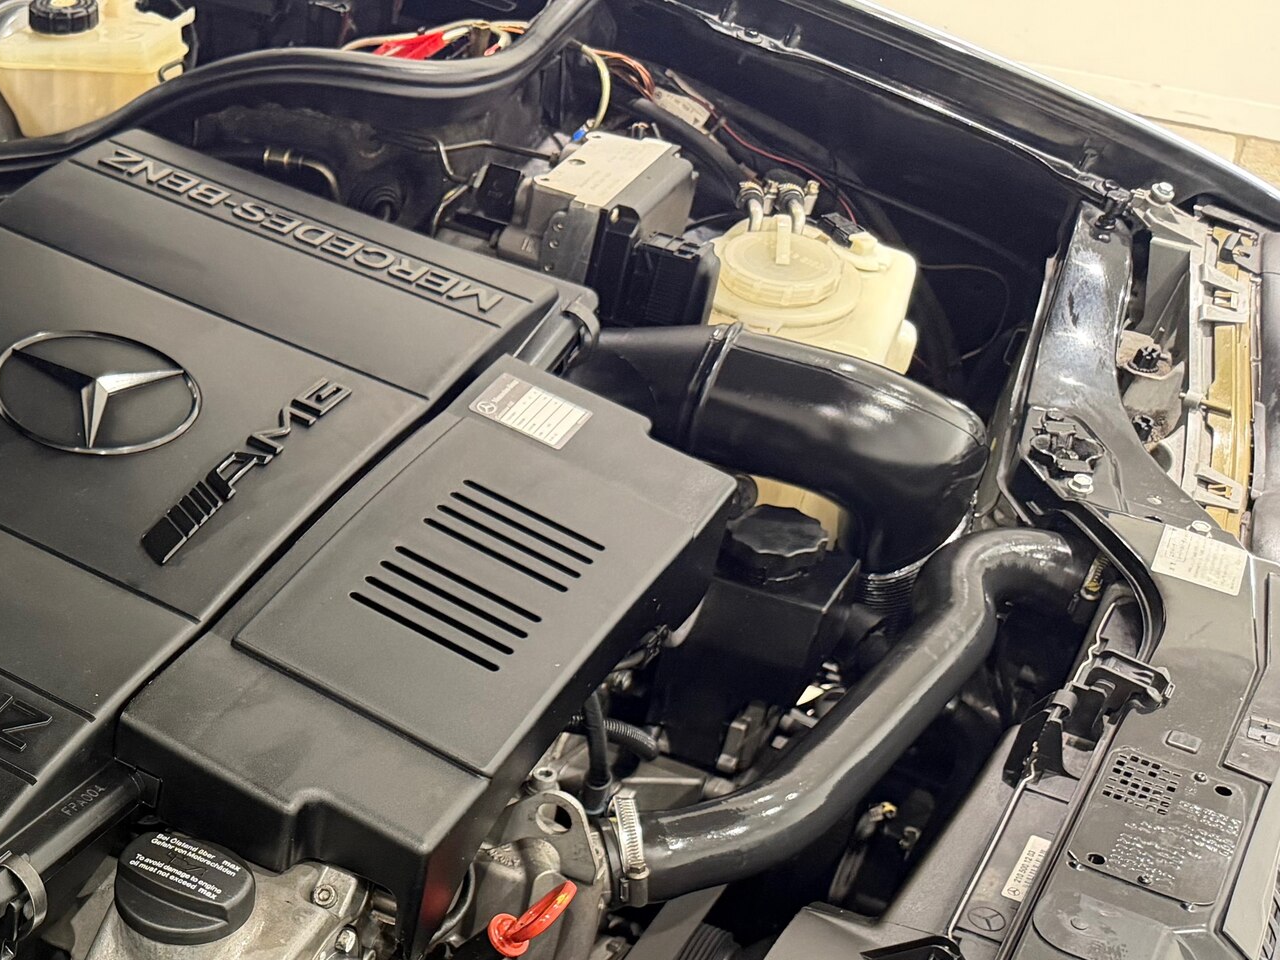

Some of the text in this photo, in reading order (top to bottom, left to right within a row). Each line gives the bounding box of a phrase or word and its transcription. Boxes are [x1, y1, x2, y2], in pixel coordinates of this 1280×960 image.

[98, 148, 506, 313] MERCEDES-BENZ
[151, 838, 236, 877] Gefahr von Motorschäden
[156, 833, 241, 872] Bei Ölstand über max
[138, 862, 157, 873] must
[156, 869, 169, 878] not
[169, 875, 198, 890] exceed
[198, 888, 217, 900] max
[144, 856, 164, 868] avoid
[163, 864, 191, 879] damage
[190, 875, 198, 883] to
[198, 879, 222, 894] engine
